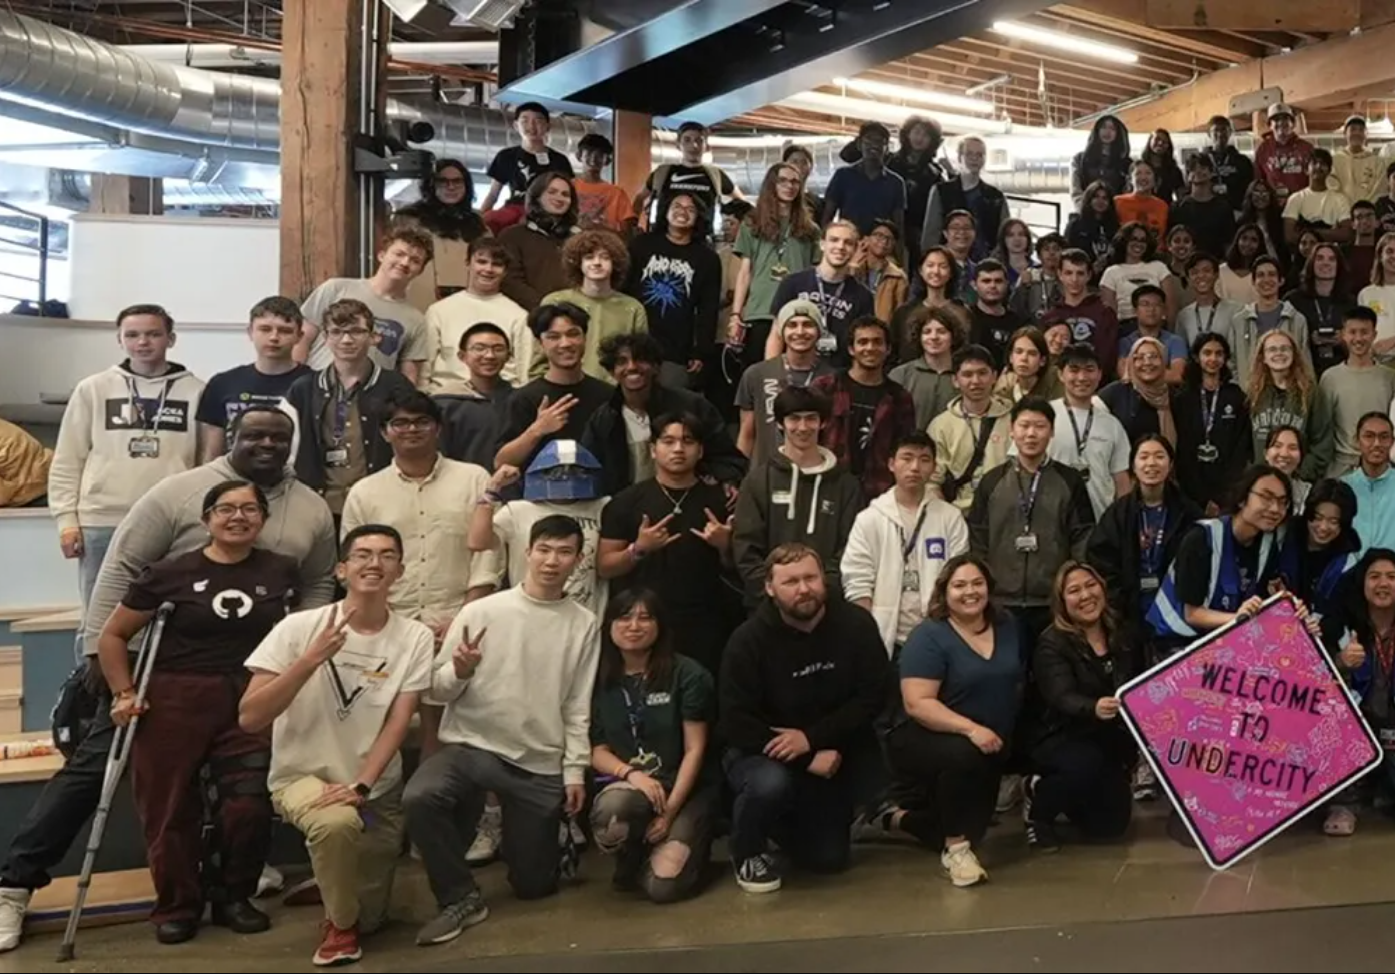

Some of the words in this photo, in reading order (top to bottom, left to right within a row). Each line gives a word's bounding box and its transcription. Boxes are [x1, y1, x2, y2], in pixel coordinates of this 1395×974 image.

[1201, 664, 1327, 715] WELCOME
[1237, 711, 1270, 743] TO
[1168, 740, 1317, 793] UNDERCITY
